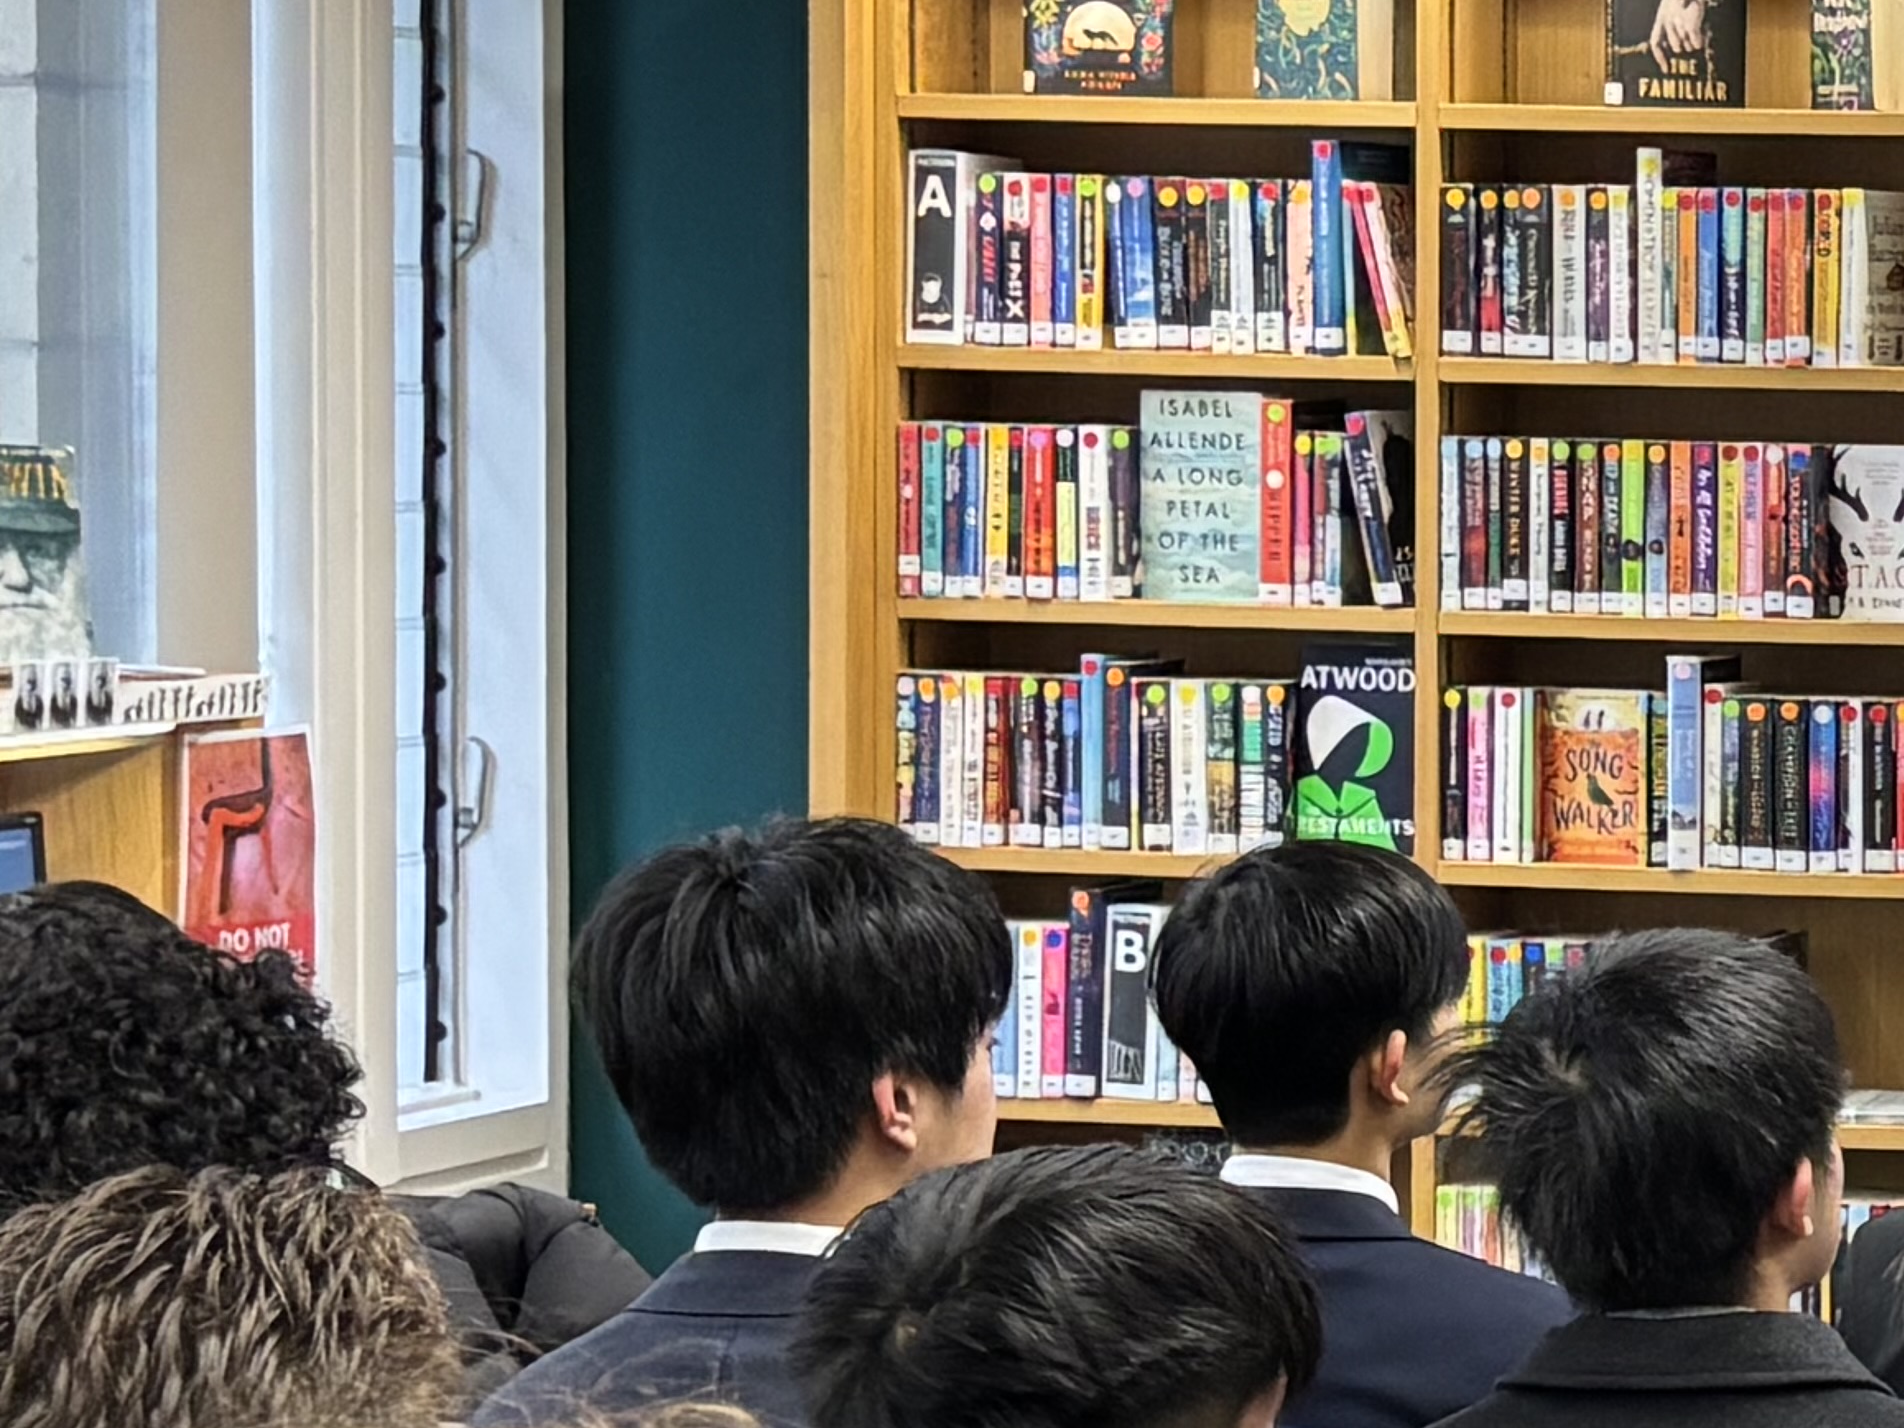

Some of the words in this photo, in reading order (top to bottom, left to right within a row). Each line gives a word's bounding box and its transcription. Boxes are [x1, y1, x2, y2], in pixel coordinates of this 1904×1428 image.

[1670, 57, 1698, 77] THE
[1637, 78, 1728, 103] FAMILIAR
[916, 174, 952, 218] A
[1159, 398, 1233, 419] ISABEL
[1149, 432, 1246, 451] ALLENDE
[1152, 468, 1167, 484] A
[1178, 467, 1245, 486] LONG
[1166, 499, 1231, 519] PETAL
[1158, 532, 1189, 551] OF
[1198, 531, 1240, 552] THE
[1178, 564, 1221, 585] SEA
[1300, 665, 1416, 693] ATWOOD
[1563, 748, 1624, 780] SONG
[1553, 795, 1638, 834] WALKER
[219, 928, 249, 951] DO
[254, 922, 292, 949] NOT
[1115, 928, 1146, 972] B
